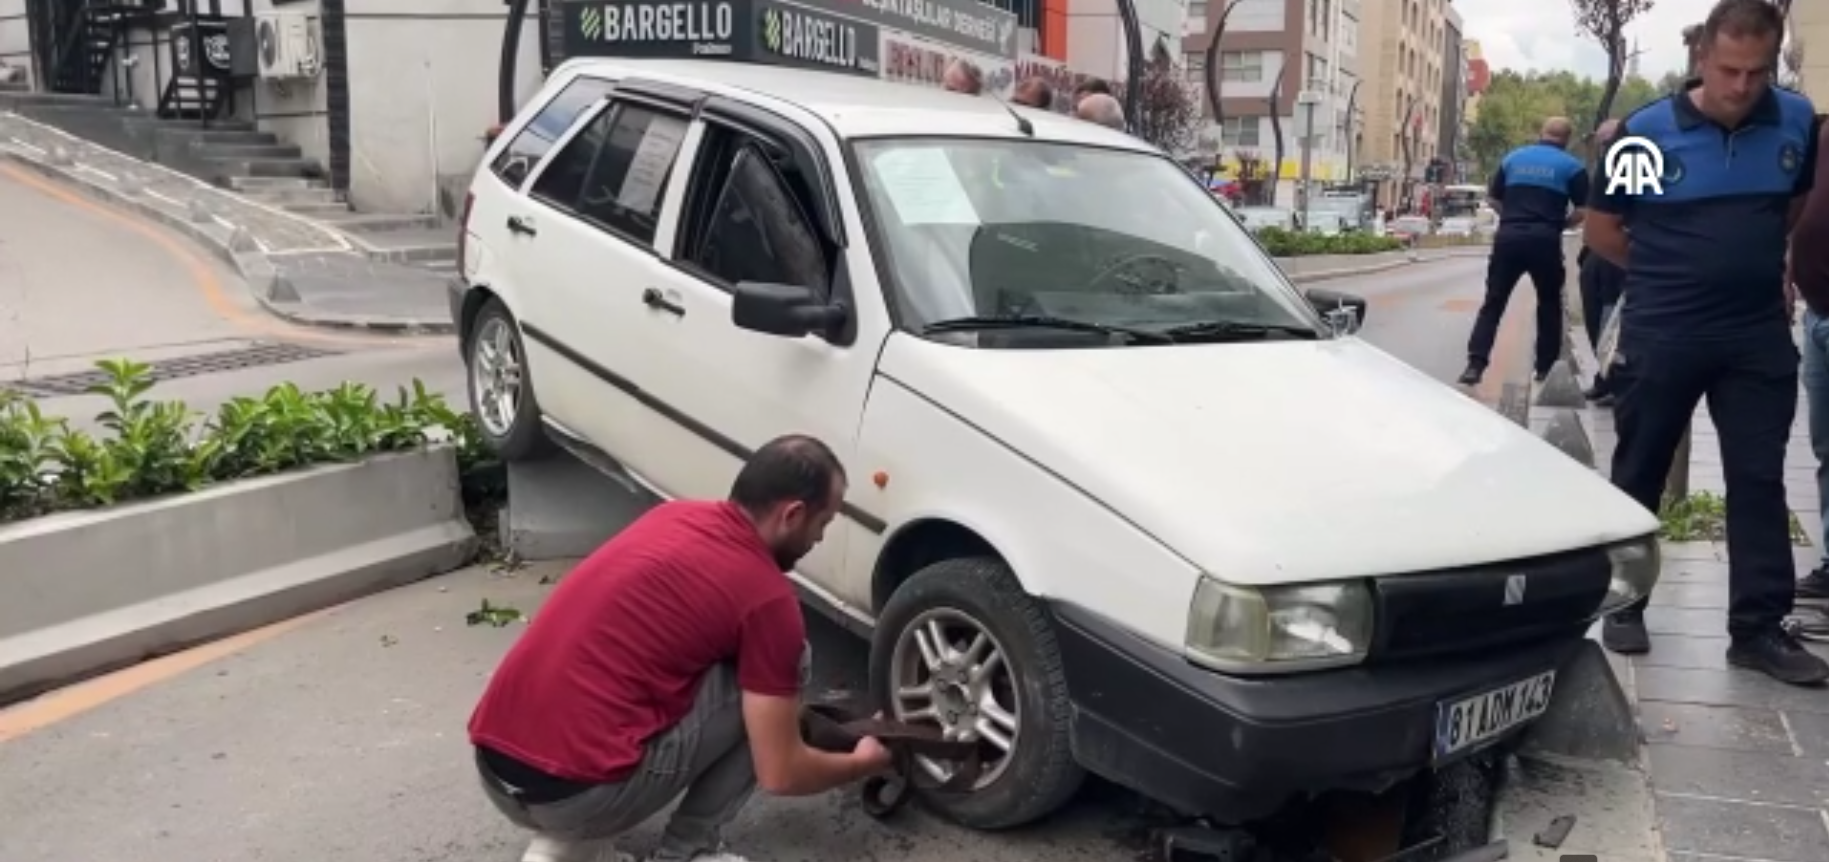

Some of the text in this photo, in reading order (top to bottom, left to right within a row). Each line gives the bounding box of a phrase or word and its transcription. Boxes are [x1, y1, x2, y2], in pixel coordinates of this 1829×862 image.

[604, 3, 732, 41] BARGELLO
[782, 11, 856, 67] BARGELLO
[1450, 702, 1474, 746] 81
